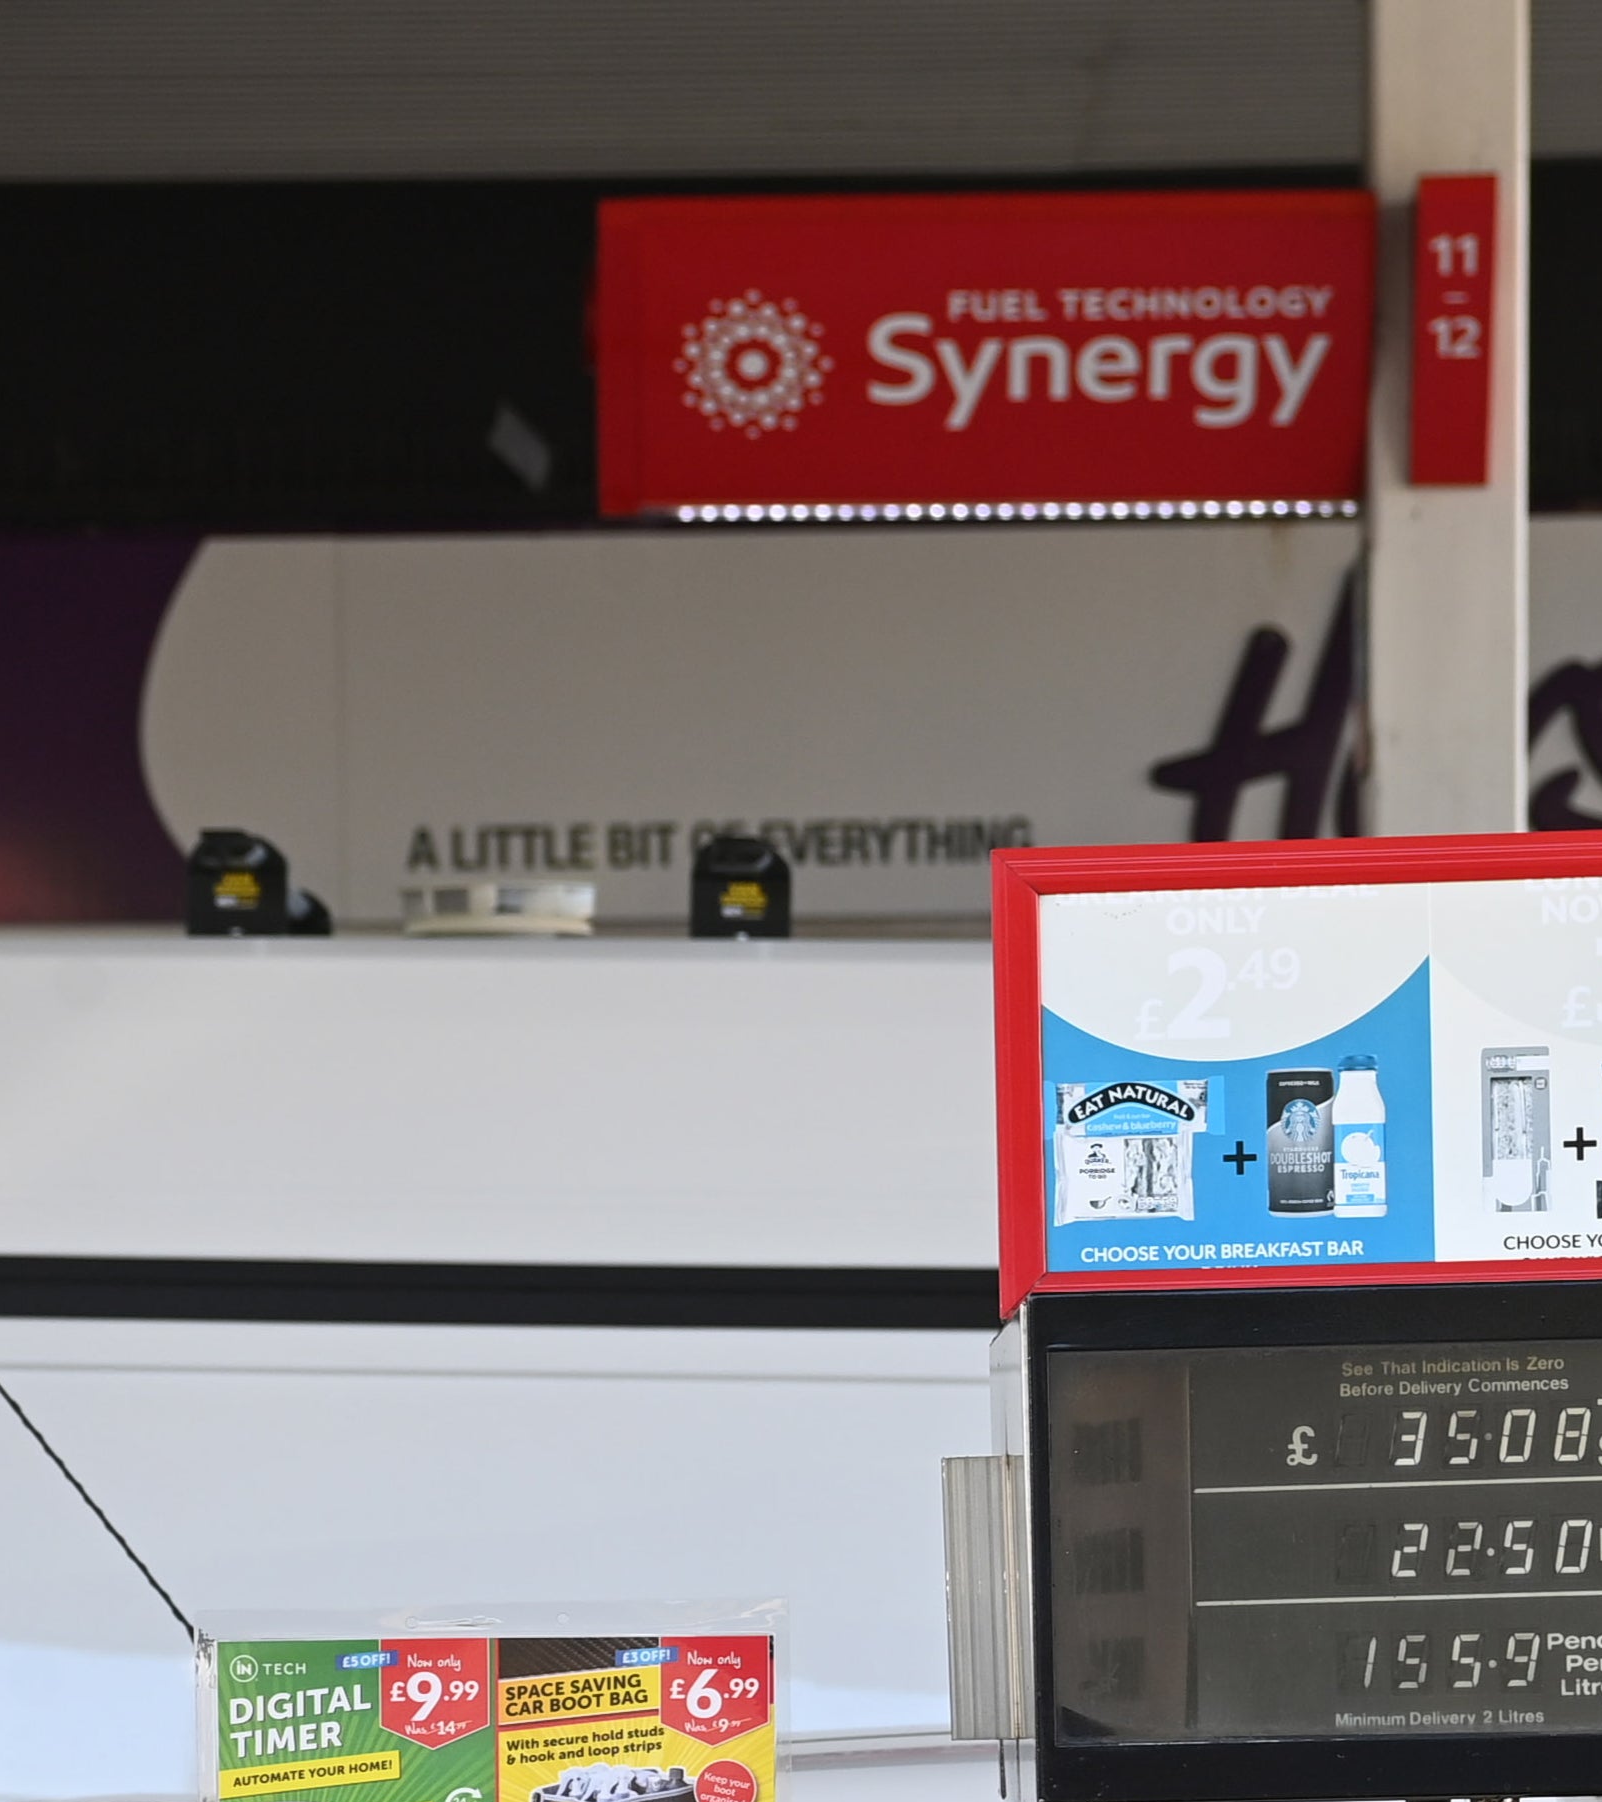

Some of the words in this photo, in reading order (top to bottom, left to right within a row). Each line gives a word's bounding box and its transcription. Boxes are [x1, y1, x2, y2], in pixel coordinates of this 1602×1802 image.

[1429, 236, 1480, 275] 11
[948, 291, 1046, 322] FUEL
[1059, 285, 1333, 320] TECHNOLOGY
[1429, 320, 1481, 357] 12
[866, 312, 1332, 430] Synergy
[405, 827, 437, 872] A
[451, 824, 595, 871] LITTLE
[607, 823, 677, 868] BIT
[1080, 1245, 1160, 1264] CHOOSE
[1162, 1243, 1217, 1262] YOUR
[1220, 1240, 1324, 1260] BREAKFAST
[1327, 1239, 1364, 1257] BAR
[1504, 1234, 1582, 1251] CHOOSE
[1341, 1362, 1373, 1379] See
[1380, 1360, 1417, 1376] That
[1422, 1358, 1502, 1376] Indication
[1505, 1357, 1520, 1373] Is
[1526, 1355, 1565, 1372] Zero
[1339, 1381, 1394, 1399] Before
[1399, 1380, 1462, 1399] Delivery
[1467, 1377, 1570, 1395] Commences
[1285, 1425, 1319, 1468] £
[262, 1662, 307, 1676] TECH
[505, 1681, 565, 1700] SPACE
[570, 1673, 642, 1693] SAVING
[229, 1685, 371, 1726] DIGITAL
[390, 1671, 480, 1722] £9.99
[505, 1700, 544, 1717] CAR
[550, 1694, 604, 1713] BOOT
[609, 1688, 648, 1709] BAG
[669, 1668, 759, 1718] £6.99
[1335, 1712, 1406, 1728] Minimum
[1409, 1711, 1476, 1727] Delivery
[1482, 1709, 1493, 1725] 2
[1498, 1708, 1545, 1725] Litres
[229, 1721, 343, 1760] TIMER
[233, 1768, 306, 1788] AUTOMATE
[308, 1764, 345, 1779] YOUR
[348, 1758, 393, 1775] HOME!
